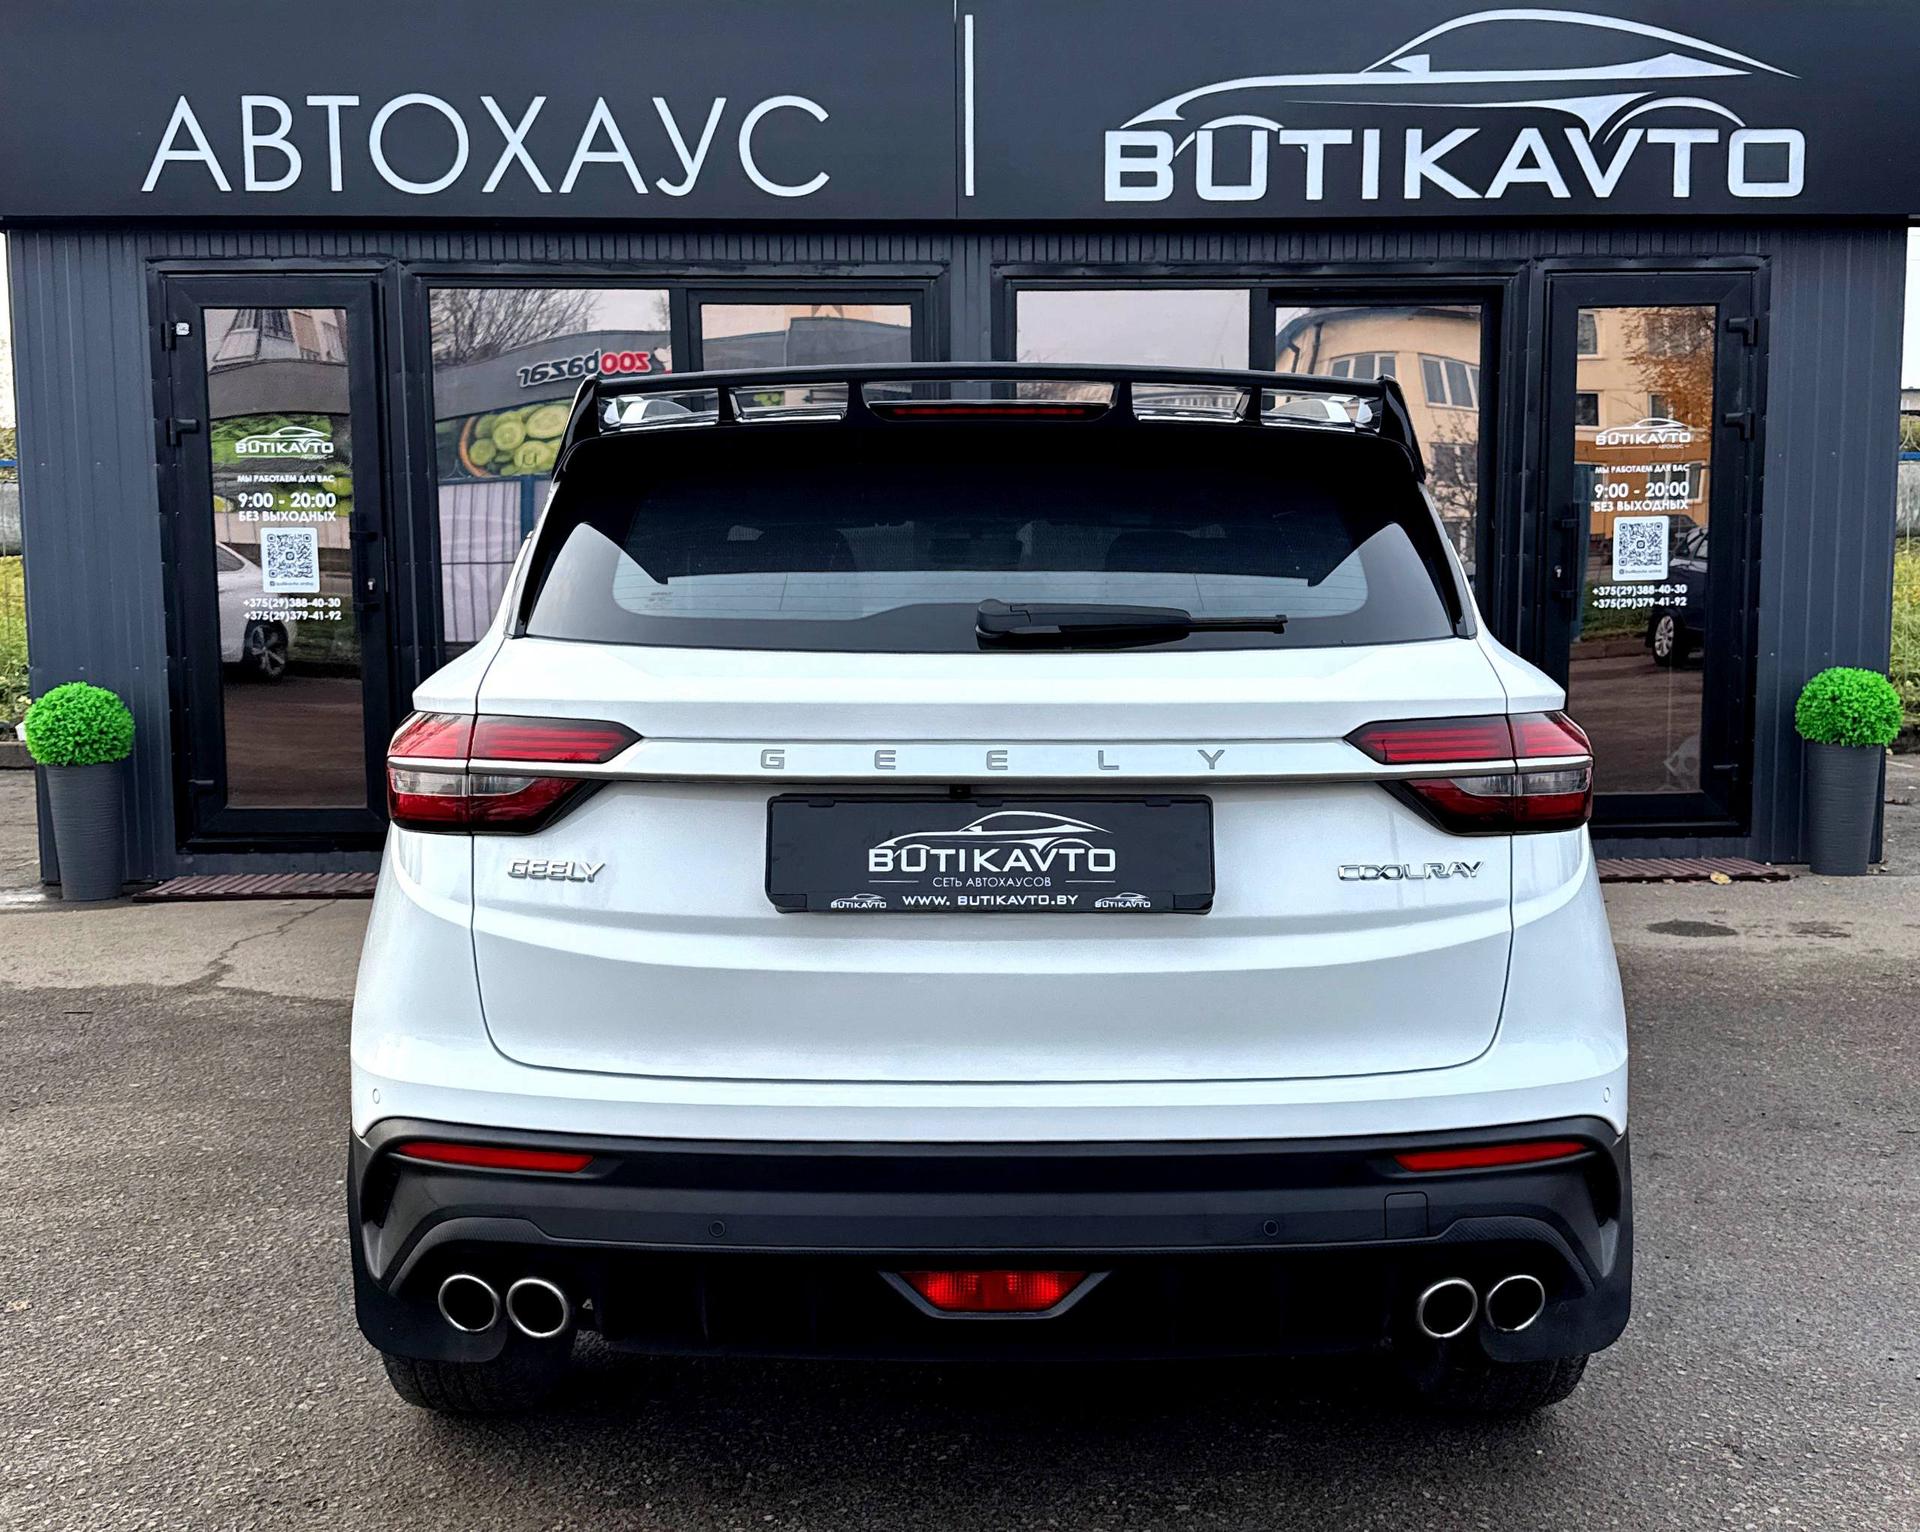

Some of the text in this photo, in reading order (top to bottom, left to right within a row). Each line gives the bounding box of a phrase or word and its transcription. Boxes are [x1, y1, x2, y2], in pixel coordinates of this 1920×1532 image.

[141, 93, 831, 198] АВТОХАУС
[1103, 127, 1806, 202] BUTIKAVTO
[1595, 432, 1691, 446] BUTIKAVTO
[235, 441, 335, 454] BUTIKAVTO
[1594, 463, 1690, 474] МЫ РАБОТАЕМ ДЛЯ ВАС
[236, 474, 336, 483] МЫ РАБОТАЕМ ДЛЯ ВАС
[1594, 483, 1629, 499] 9:00
[1645, 481, 1690, 498] 20:00
[238, 492, 274, 508] 9:00
[290, 492, 337, 508] 20:00
[1593, 499, 1689, 512] БЕЗ ВЫХОДНЫХ
[238, 510, 337, 523] БЕЗ ВЫХОДНЫХ
[1592, 584, 1688, 597] +375(29)388-40-30
[243, 597, 342, 610] +375(29)388-40-30
[1592, 596, 1688, 610] +375(29)379-41-92
[243, 610, 343, 623] +375(29)379-41-92
[759, 748, 1226, 771] GEELY
[867, 848, 1117, 873] BUTIKAVTO
[508, 858, 606, 883] GEELY
[1337, 860, 1485, 882] COOLRAY
[932, 876, 1052, 888] СЕТЬ АВТОХАУСОВ
[901, 894, 1079, 907] WWW. BUTIKAVTO.BY
